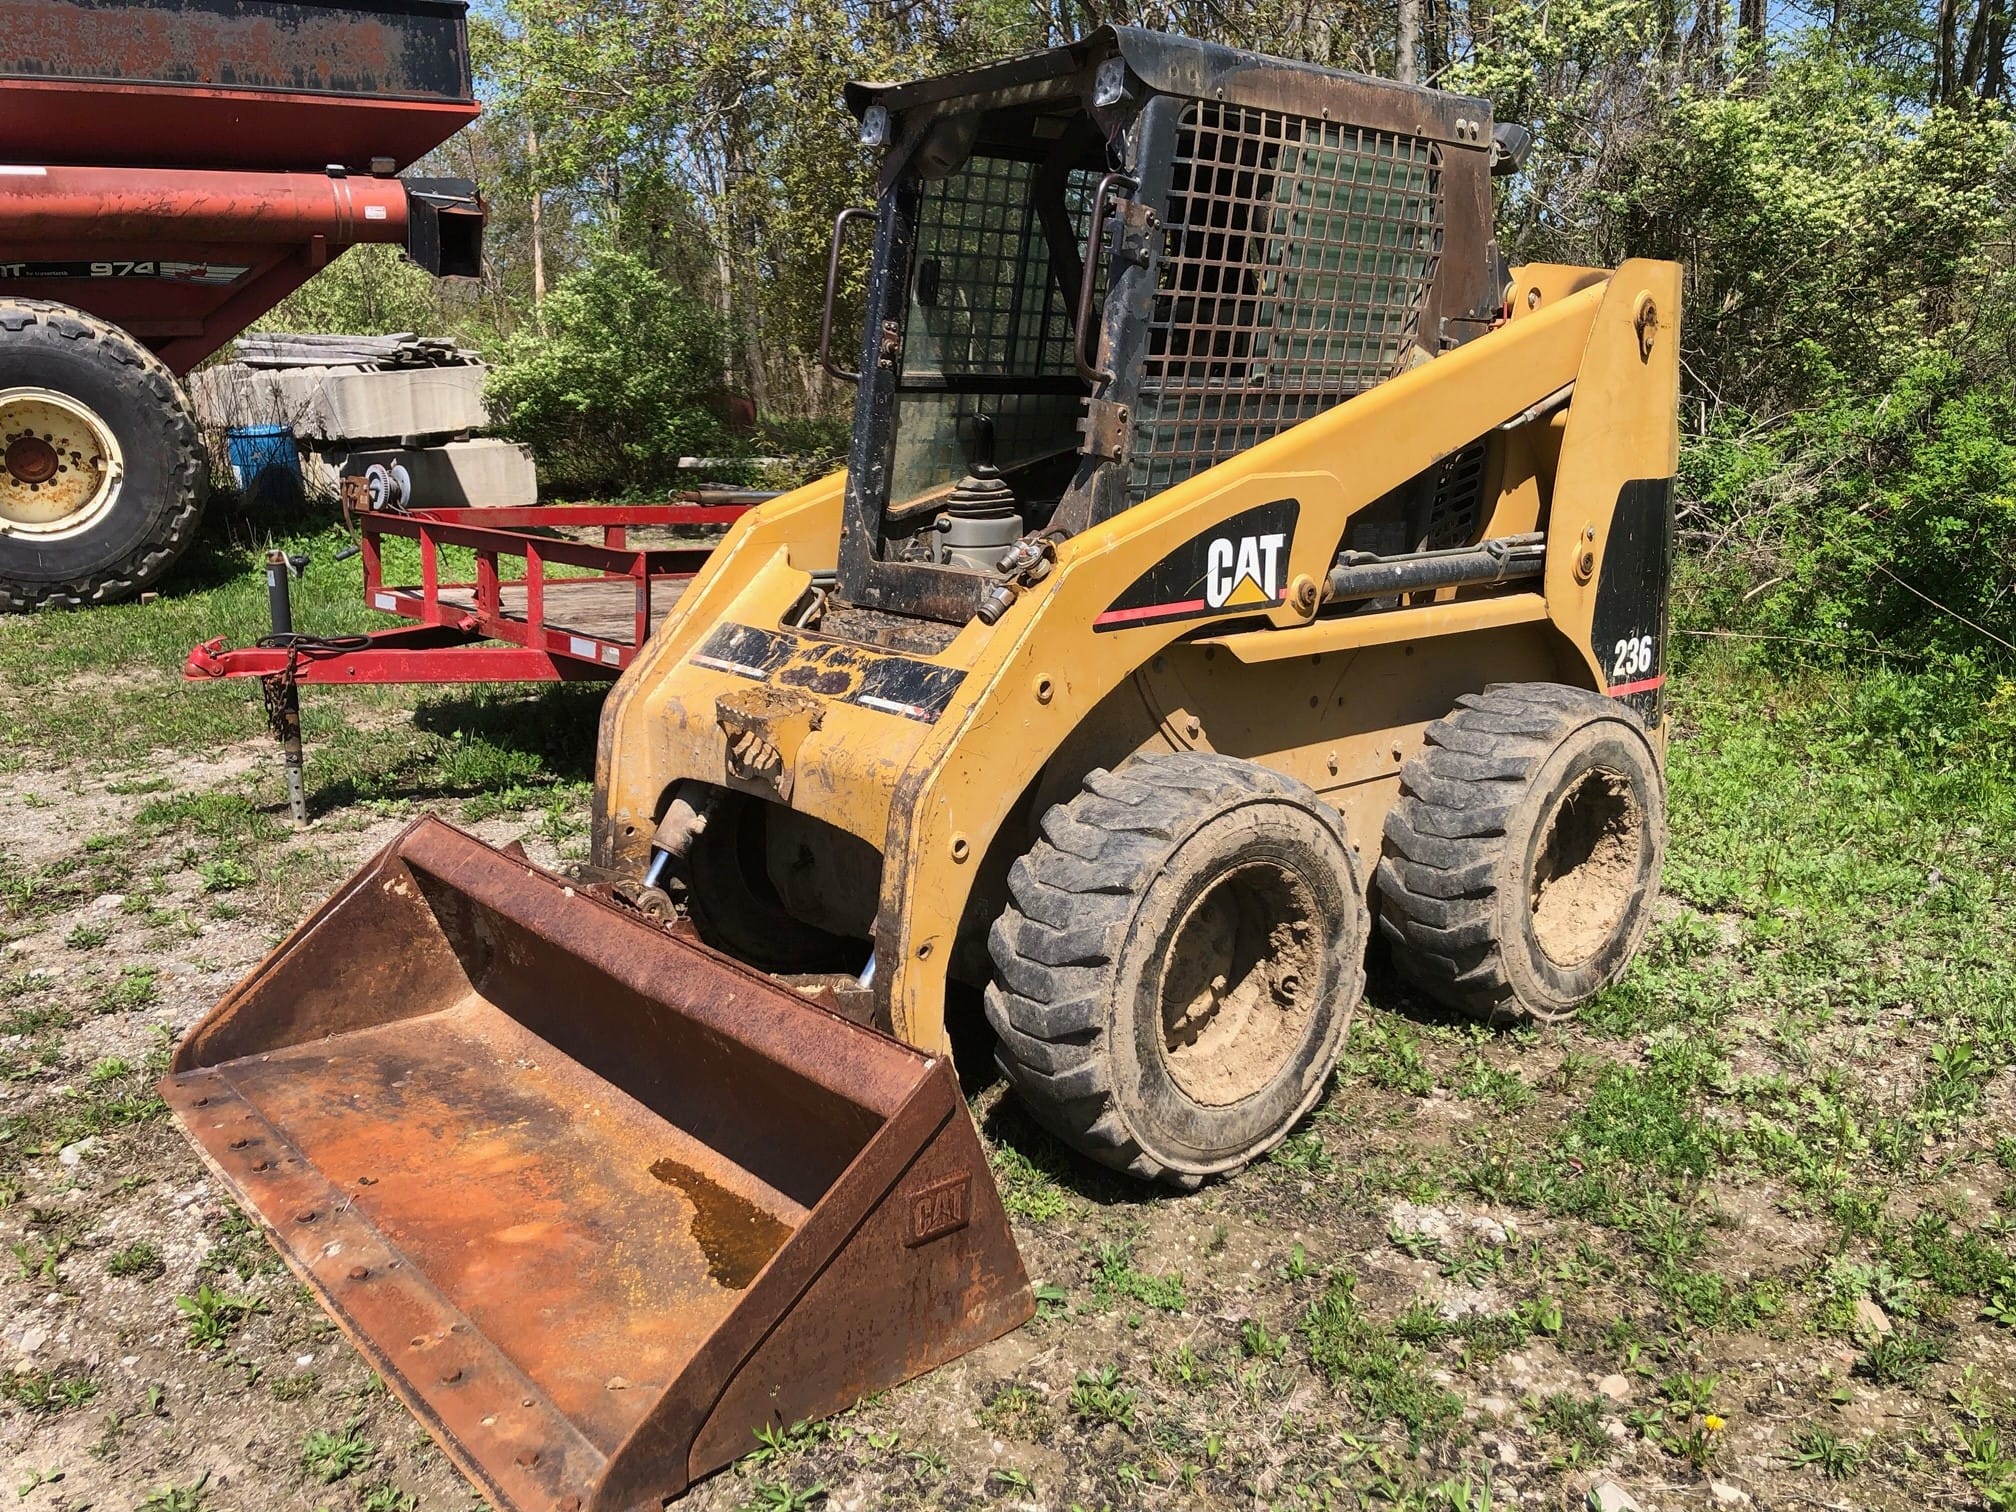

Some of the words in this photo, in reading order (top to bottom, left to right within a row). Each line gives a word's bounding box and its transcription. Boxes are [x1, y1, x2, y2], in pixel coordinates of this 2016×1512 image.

[90, 262, 154, 277] 974
[1206, 533, 1285, 609] CAT
[1612, 635, 1653, 677] 236
[914, 1183, 966, 1237] CAT
